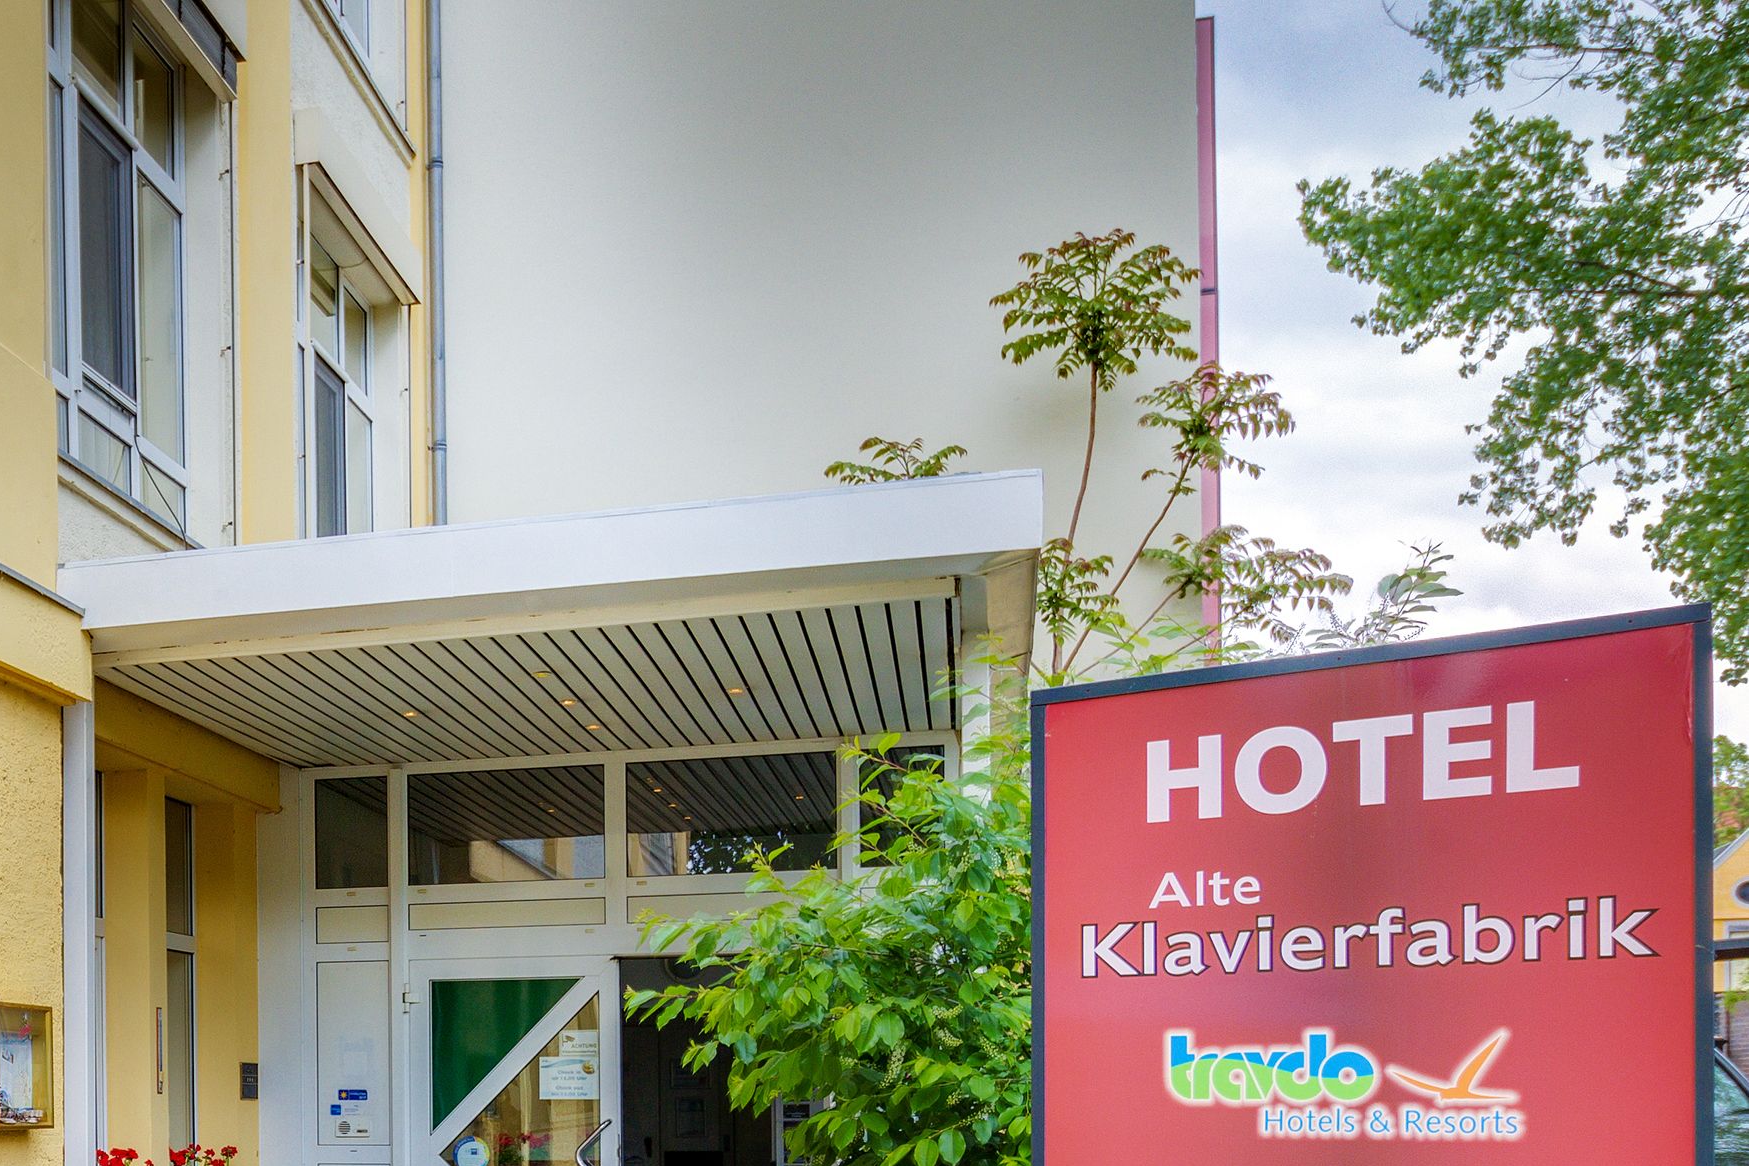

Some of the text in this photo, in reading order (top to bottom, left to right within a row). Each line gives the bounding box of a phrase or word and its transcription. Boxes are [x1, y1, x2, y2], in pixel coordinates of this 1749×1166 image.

[1146, 700, 1581, 824] HOTEL
[1148, 870, 1261, 909] Alte
[1081, 896, 1659, 978] Klavierfabrik
[1169, 1033, 1376, 1101] travdo
[1263, 1107, 1519, 1136] Hotels & Resorts
